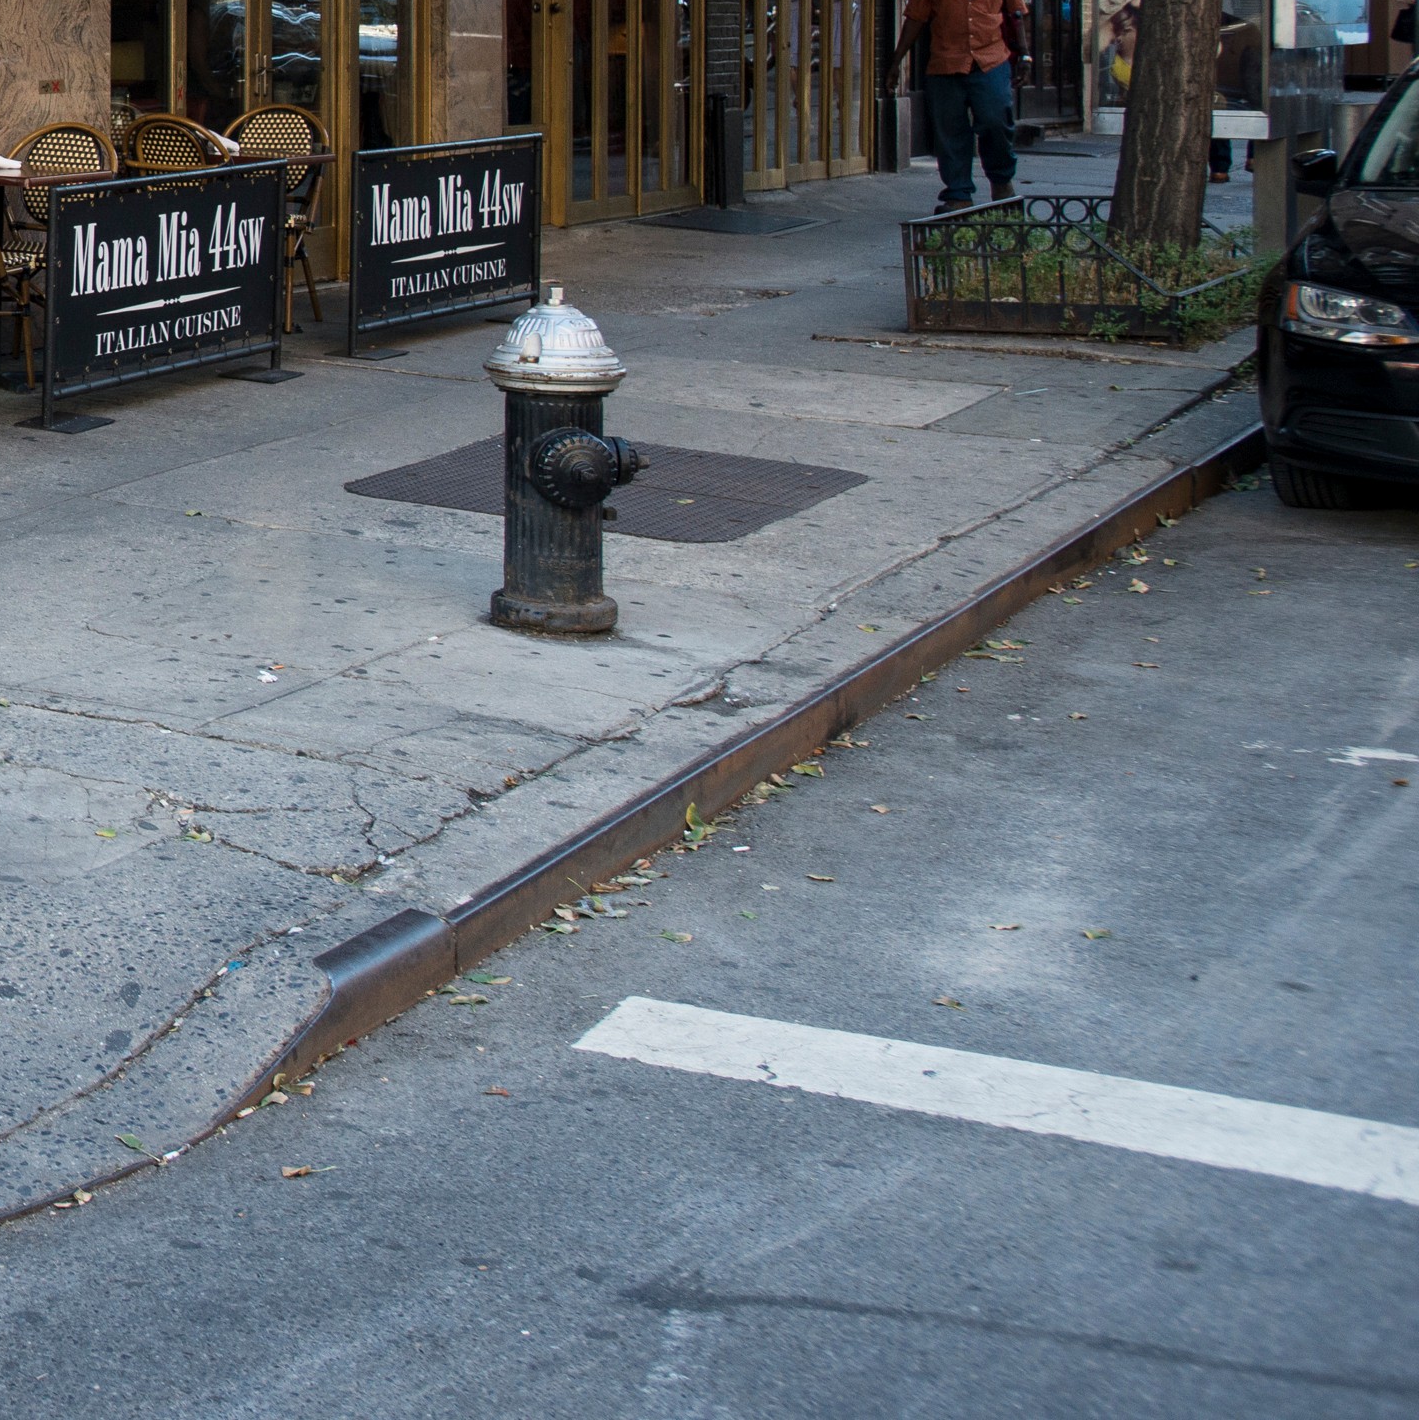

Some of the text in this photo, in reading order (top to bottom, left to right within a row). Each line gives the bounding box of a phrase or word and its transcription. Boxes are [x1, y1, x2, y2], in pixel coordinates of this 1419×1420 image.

[370, 183, 432, 247] Mama
[437, 173, 473, 236] Mia
[70, 222, 149, 297] Mama
[156, 210, 201, 283] Mia
[390, 258, 507, 299] ITALIAN CUISINE
[94, 305, 242, 357] ITALIAN CUISINE
